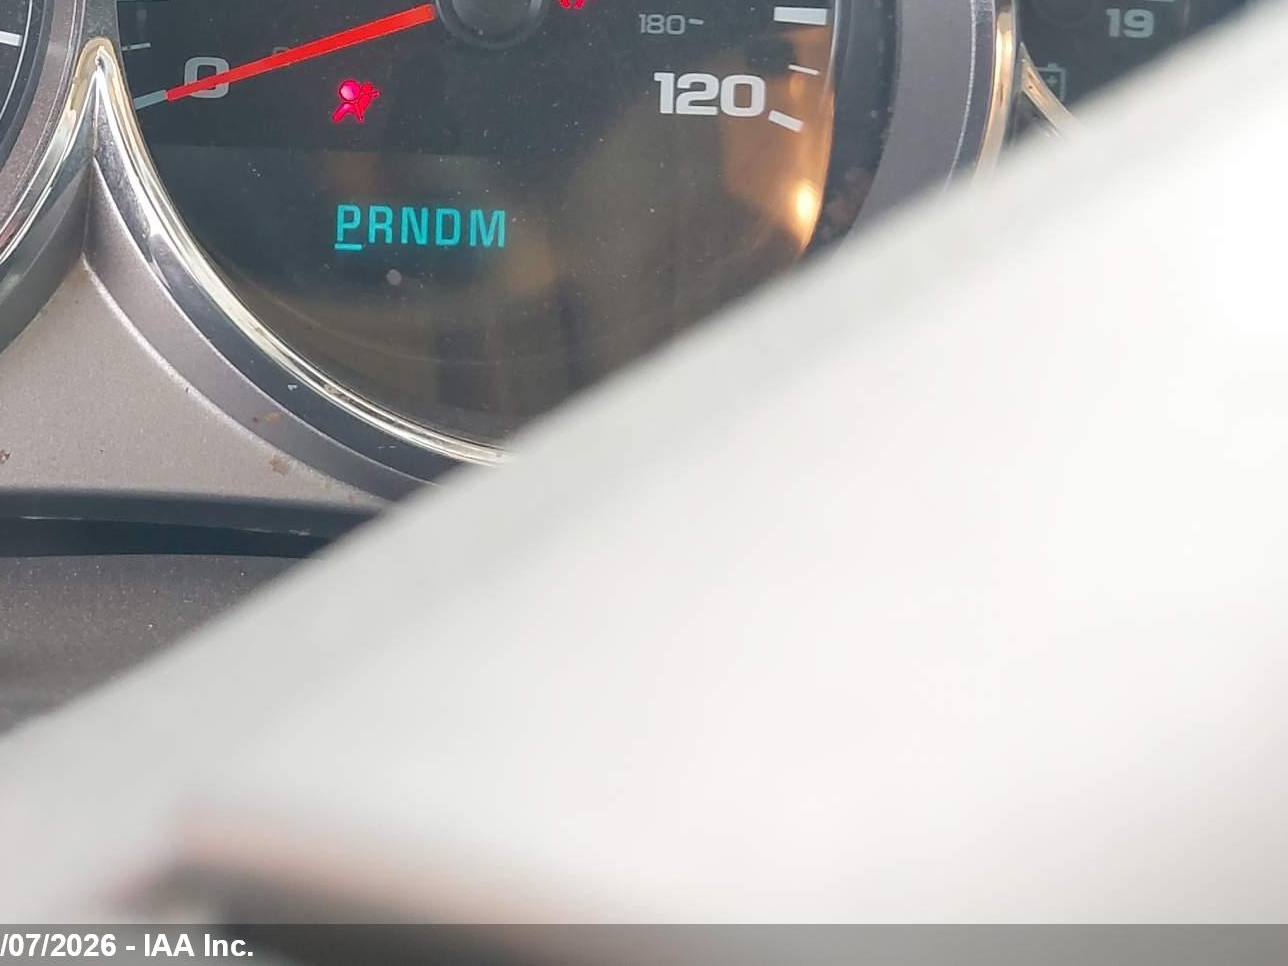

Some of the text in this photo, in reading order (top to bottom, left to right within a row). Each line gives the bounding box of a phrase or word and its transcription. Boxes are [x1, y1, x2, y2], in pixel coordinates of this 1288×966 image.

[639, 14, 686, 36] 180
[1105, 8, 1155, 38] 19
[184, 56, 229, 98] 0
[654, 71, 765, 116] 120
[334, 205, 506, 249] PRNDM
